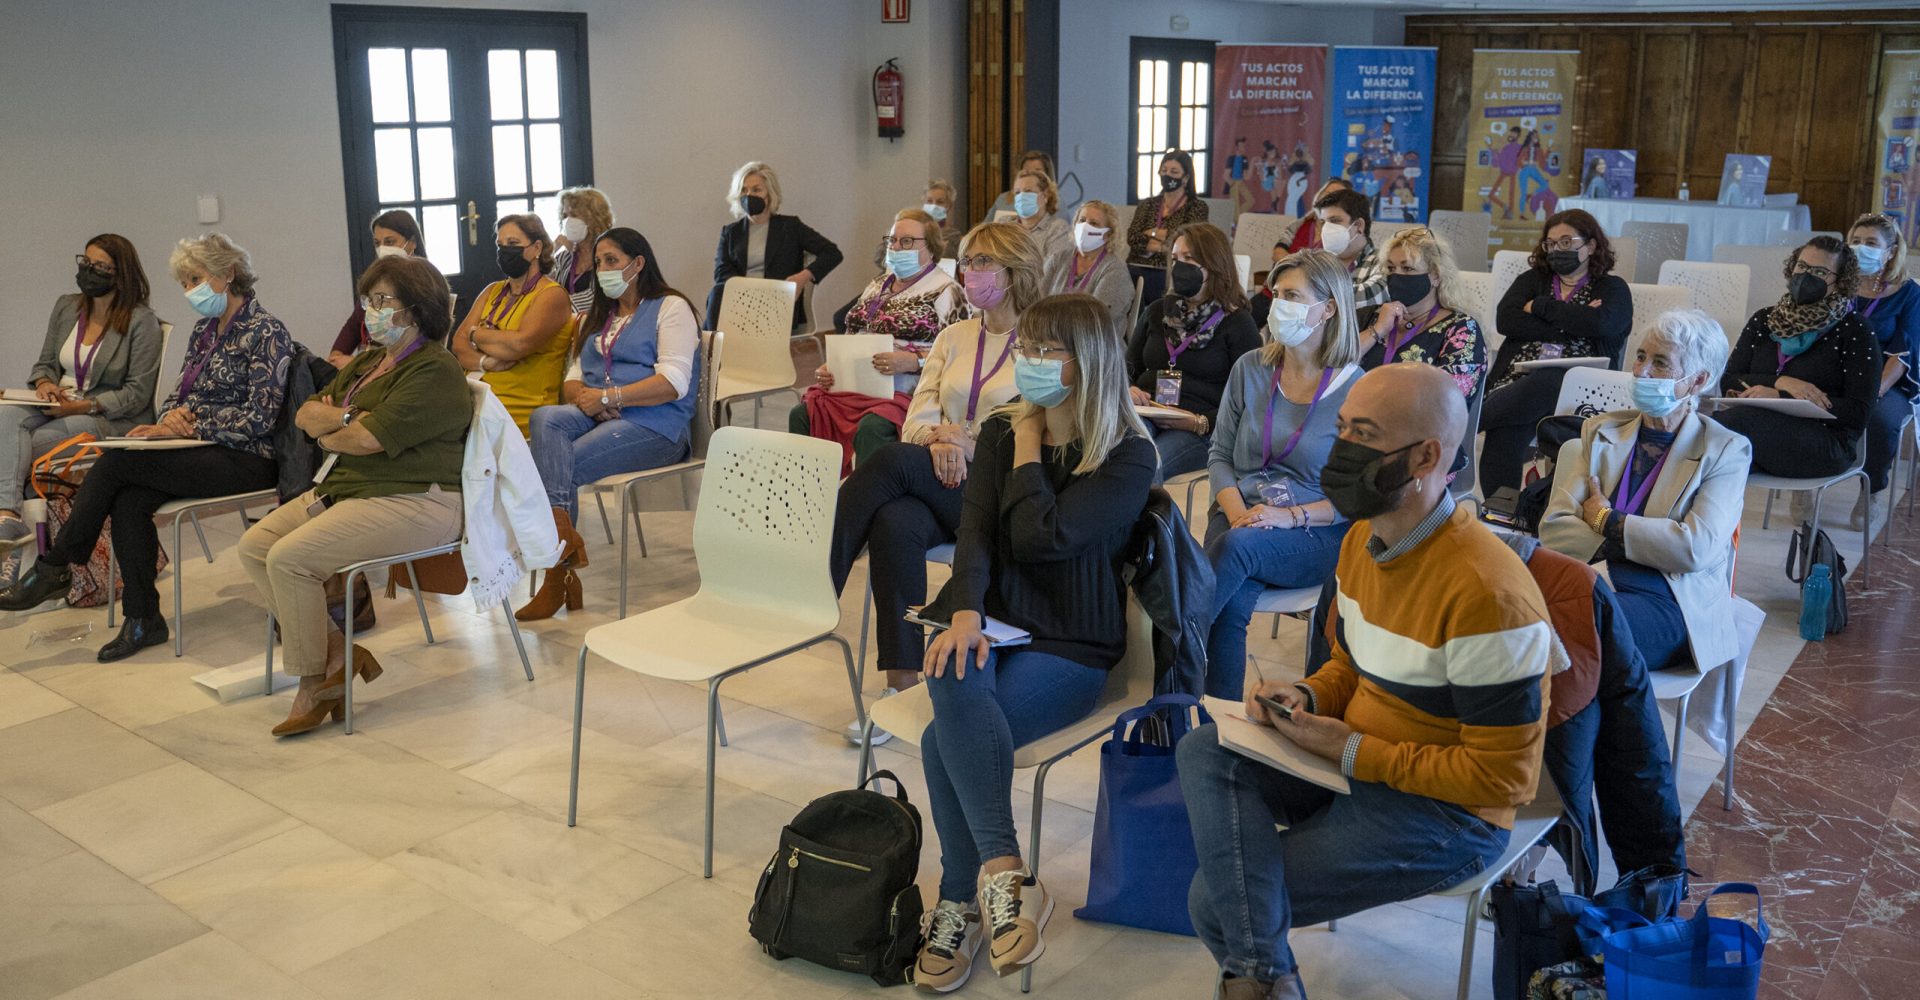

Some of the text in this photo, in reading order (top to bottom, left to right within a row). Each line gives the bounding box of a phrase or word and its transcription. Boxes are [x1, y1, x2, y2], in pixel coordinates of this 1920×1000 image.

[1241, 63, 1304, 73] TUS ACTOS
[1358, 65, 1415, 75] TUS ACTOS
[1497, 68, 1555, 77] TUS ACTOS
[1246, 76, 1297, 86] MARCAN
[1363, 78, 1409, 87] MARCAN
[1501, 80, 1549, 89] MARCAN
[1229, 89, 1313, 100] LA DIFERENCIA
[1346, 90, 1424, 100] LA DIFERENCIA
[1484, 91, 1563, 101] LA DIFERENCIA
